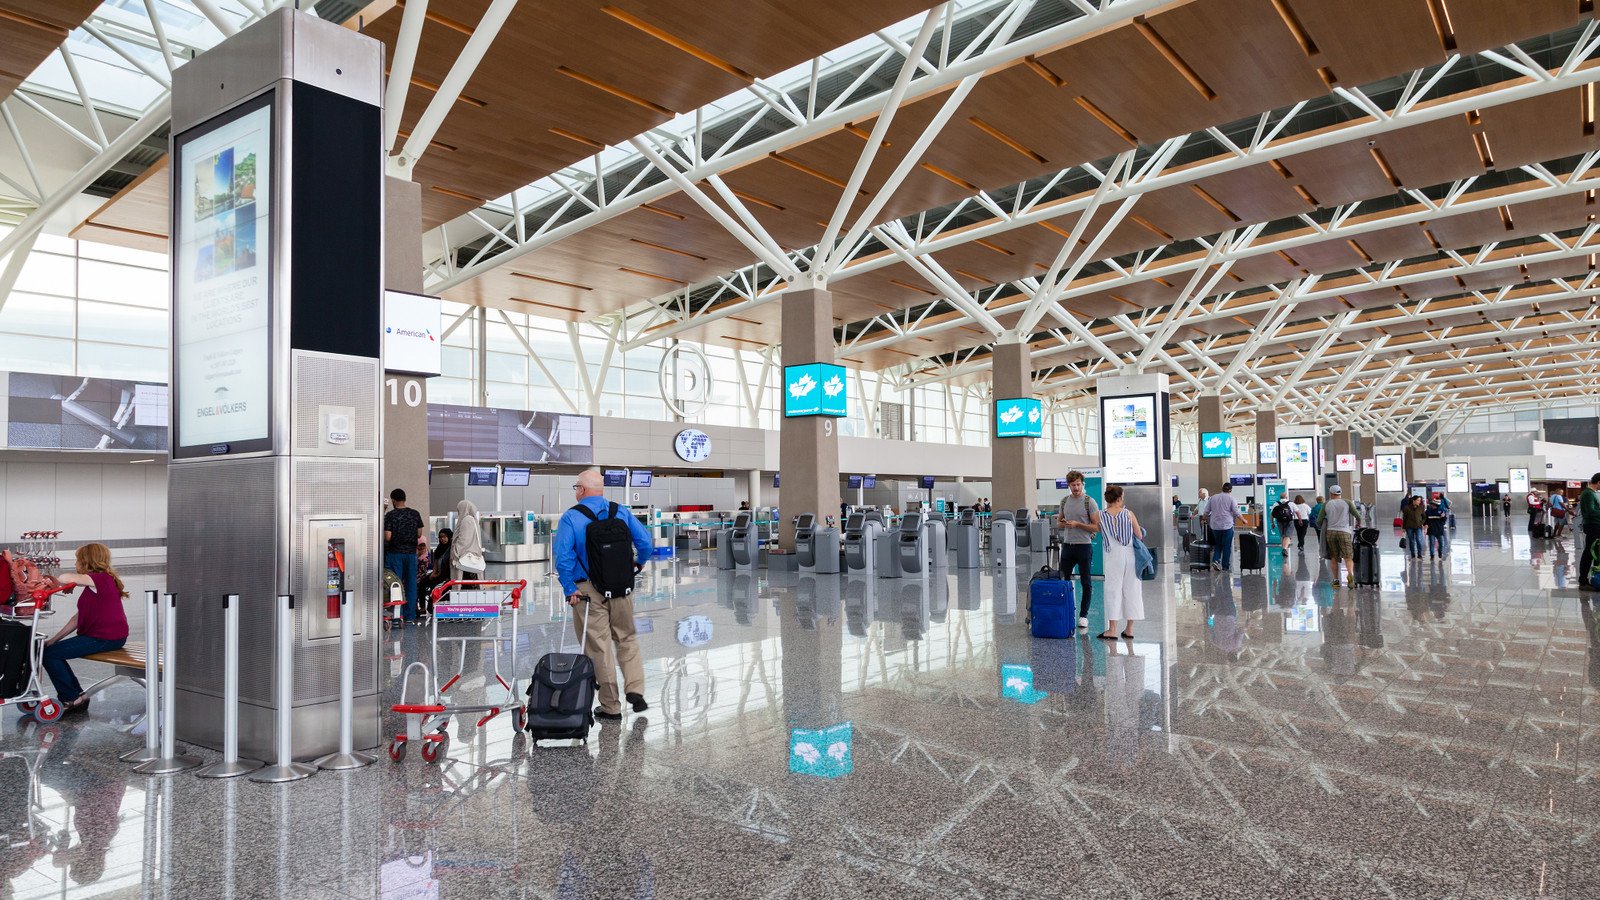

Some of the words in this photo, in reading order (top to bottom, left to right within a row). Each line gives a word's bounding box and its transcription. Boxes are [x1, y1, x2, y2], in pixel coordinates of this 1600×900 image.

[242, 275, 258, 289] OUR
[198, 311, 211, 321] THE
[241, 298, 260, 311] BEST
[396, 328, 426, 338] American
[672, 357, 705, 401] D
[386, 378, 422, 407] 10
[824, 419, 833, 437] 9
[1027, 439, 1034, 453] 8
